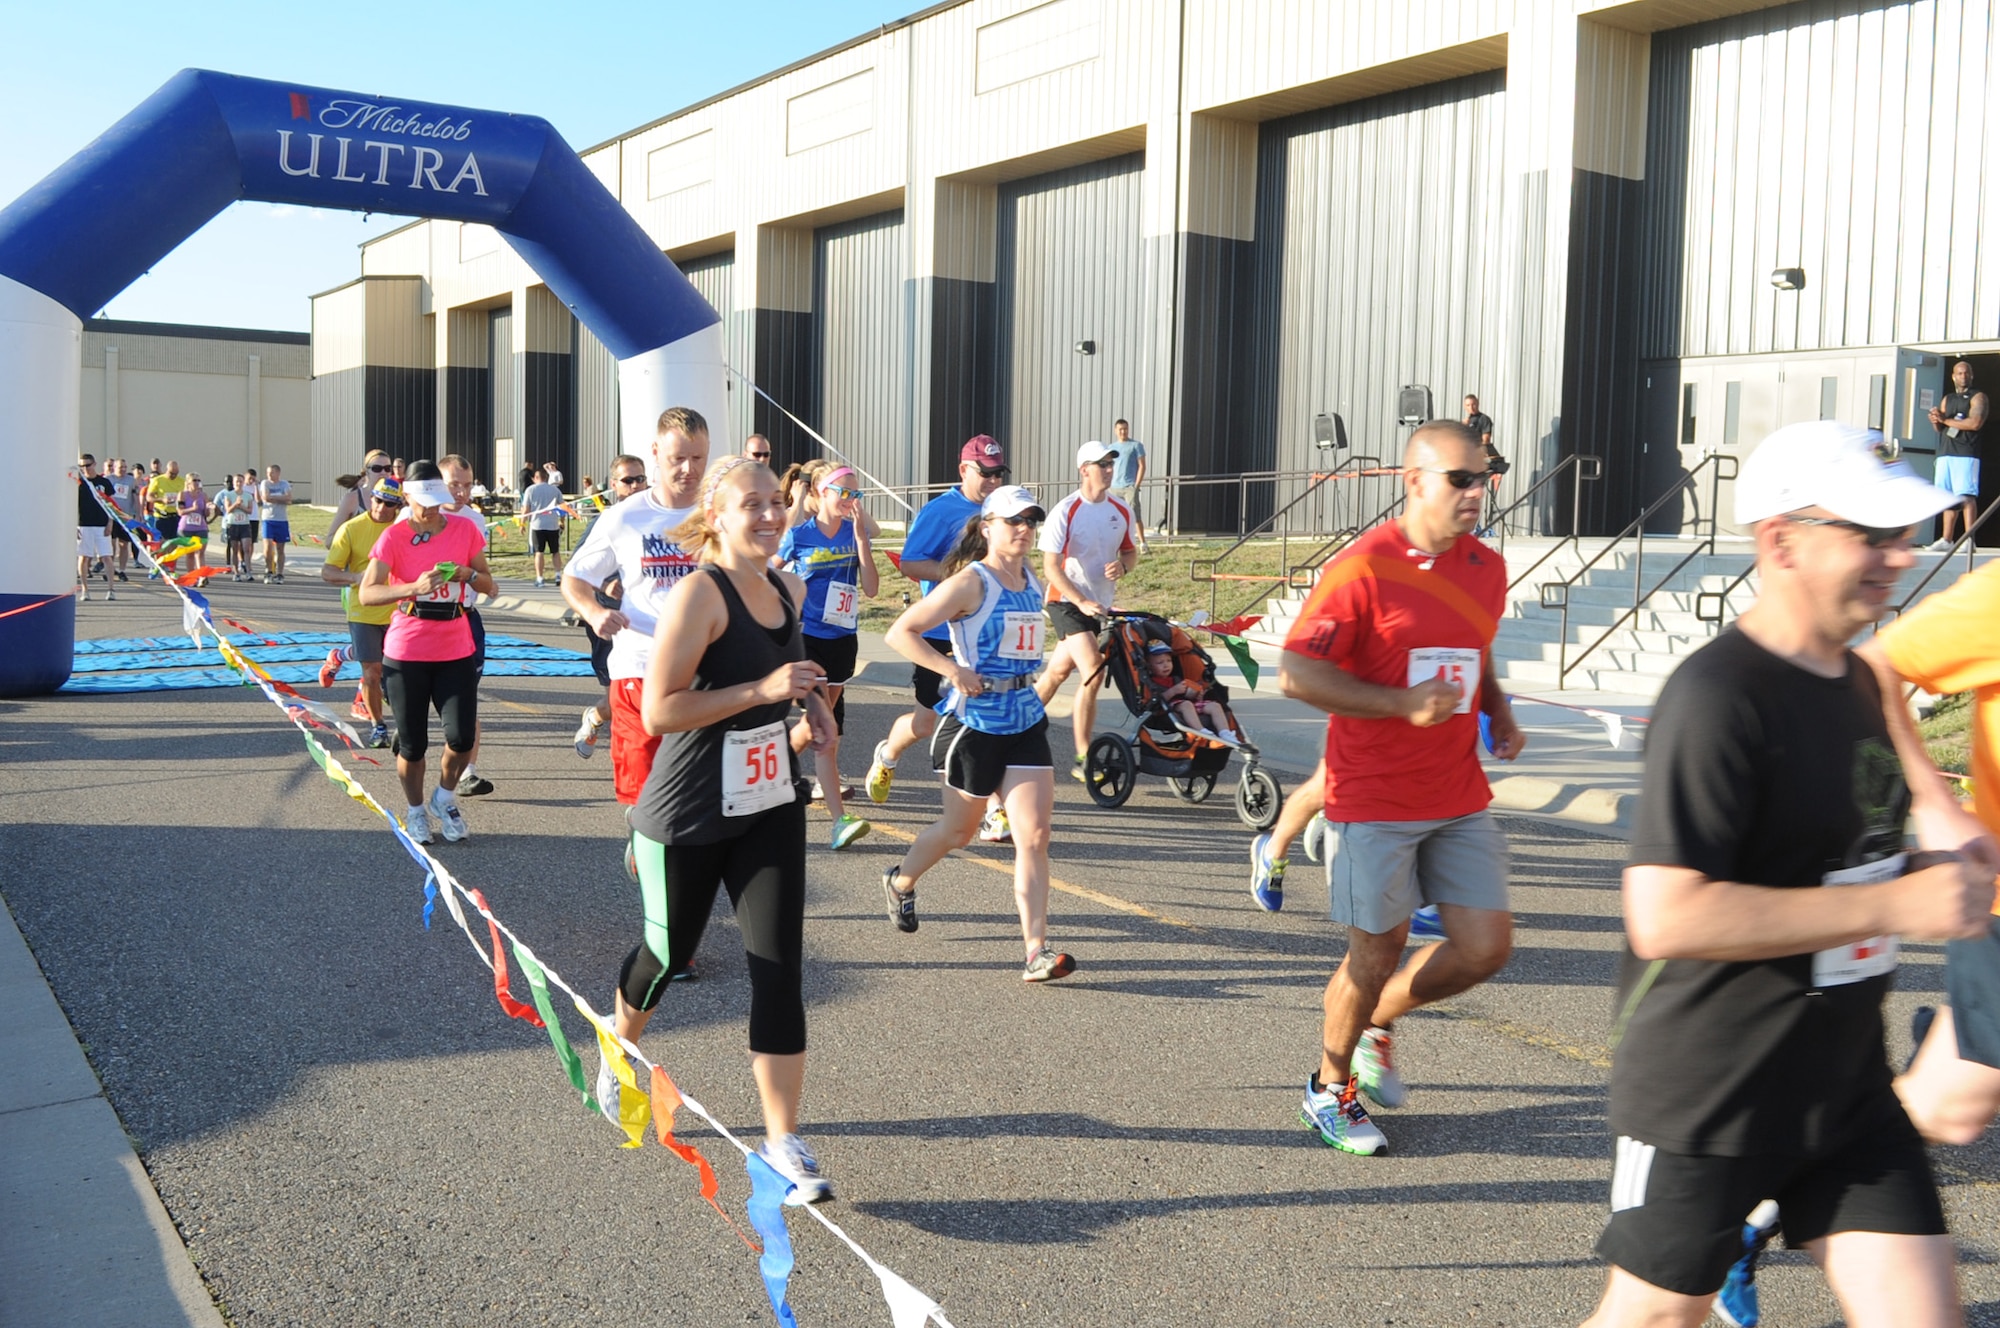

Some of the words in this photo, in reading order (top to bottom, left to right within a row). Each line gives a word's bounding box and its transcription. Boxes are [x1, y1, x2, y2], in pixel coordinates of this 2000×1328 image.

[319, 99, 472, 141] Michelob
[276, 129, 489, 196] ULTRA
[642, 565, 690, 579] STRIKER
[836, 591, 853, 613] 30
[1016, 624, 1035, 651] 11
[746, 742, 778, 785] 56
